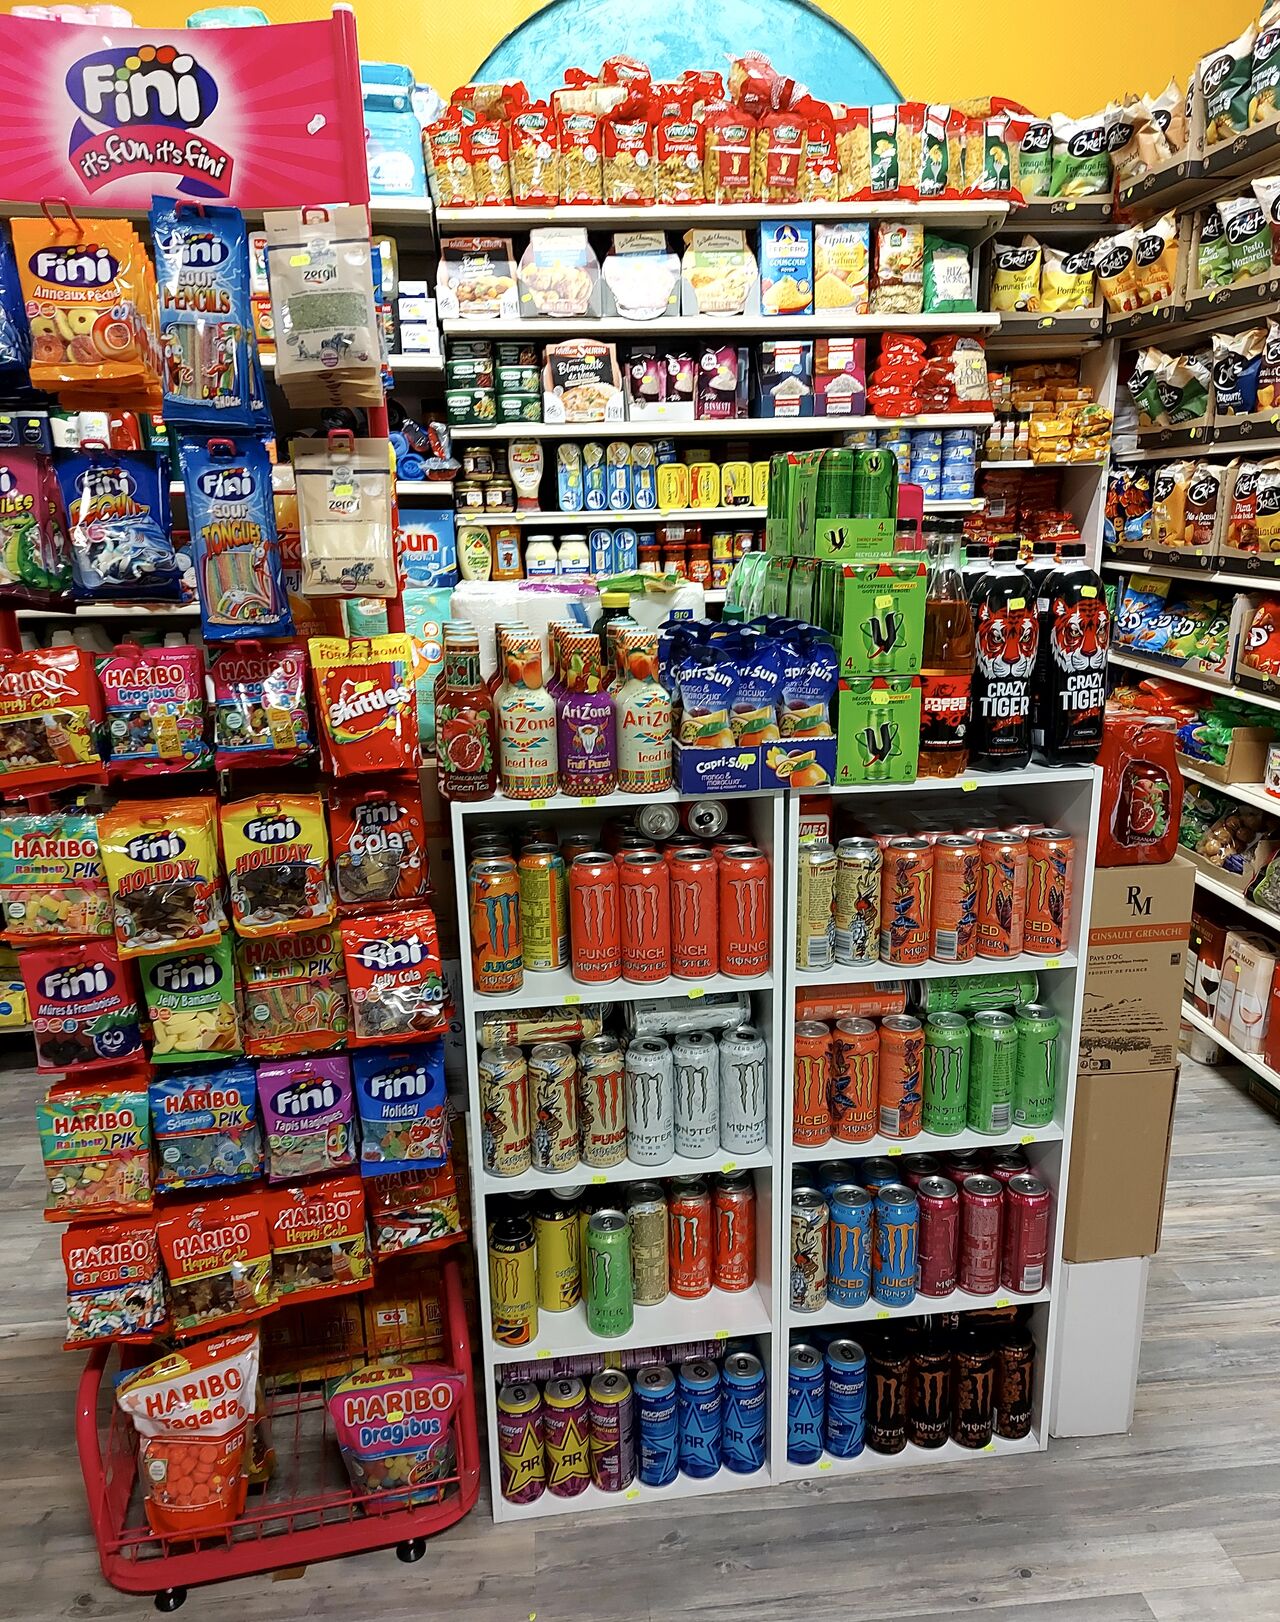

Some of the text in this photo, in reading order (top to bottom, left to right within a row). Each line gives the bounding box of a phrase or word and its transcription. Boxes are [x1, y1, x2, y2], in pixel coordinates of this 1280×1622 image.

[82, 54, 200, 124] Fini
[82, 136, 227, 178] it's fun, it's fini
[37, 248, 111, 283] Fini
[304, 264, 338, 283] zergil
[34, 286, 86, 301] Anneaux
[202, 521, 262, 558] TONGUES
[674, 610, 689, 619] aro
[106, 664, 184, 689] HARIBO
[1067, 672, 1104, 691] CRAZY
[119, 686, 176, 703] Dragibus
[987, 681, 1027, 698] CRAZY
[1059, 688, 1105, 712] TIGER
[328, 686, 411, 728] Skittles
[561, 701, 611, 721] AriZona
[980, 696, 1029, 718] TIGER
[504, 756, 548, 768] Iced tea
[567, 758, 611, 769] Fruit Punch
[639, 751, 661, 763] Iced
[447, 781, 489, 793] Green Tea
[248, 818, 295, 842] Fini
[13, 840, 98, 860] HARIBO
[129, 831, 181, 861] Fini
[350, 832, 403, 857] Cola
[236, 843, 313, 876] HOLIDAY
[118, 858, 199, 897] HOLIDAY
[1091, 927, 1183, 942] CINSAULT GRENACHE
[244, 933, 333, 965] HARIBO
[44, 962, 108, 999] Fini
[156, 956, 216, 990] Fini
[399, 968, 421, 983] Cola
[157, 991, 221, 1008] Jelly Bananas
[371, 1068, 427, 1100] Fini
[166, 1089, 240, 1114] HARIBO
[277, 1080, 335, 1115] Fini
[54, 1109, 133, 1136] HARIBO
[275, 1110, 344, 1135] Tapis Magiques
[382, 1103, 419, 1119] Holiday
[173, 1223, 250, 1260] HARIBO
[69, 1241, 149, 1271] HARIBO
[74, 1263, 145, 1285] Car en Sac
[351, 1367, 406, 1386] PACK XL
[145, 1368, 241, 1418] HARIBO
[346, 1384, 454, 1426] HARIBO
[162, 1397, 239, 1432] Tagada
[360, 1418, 440, 1448] Dragibus
